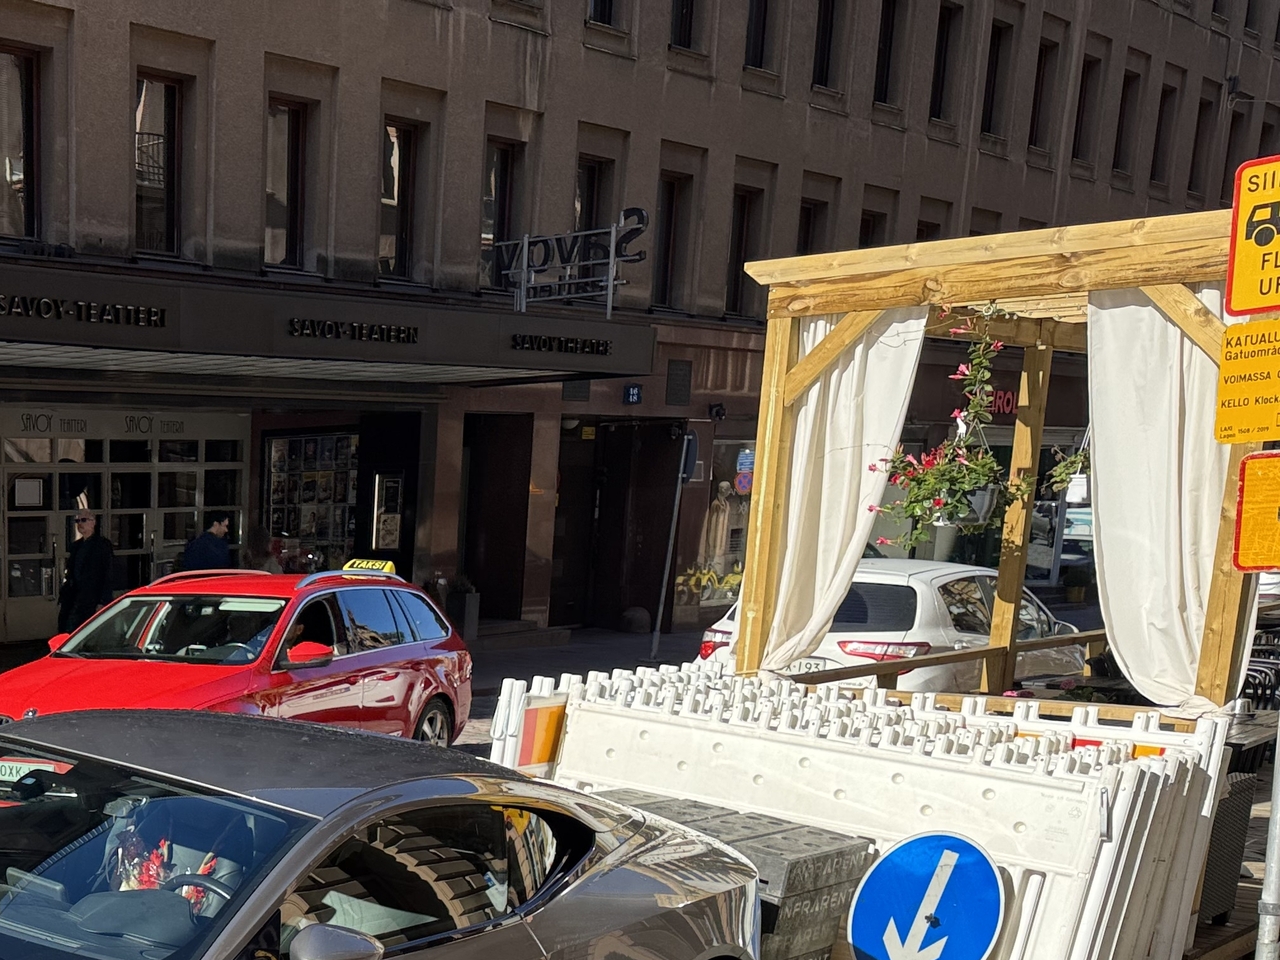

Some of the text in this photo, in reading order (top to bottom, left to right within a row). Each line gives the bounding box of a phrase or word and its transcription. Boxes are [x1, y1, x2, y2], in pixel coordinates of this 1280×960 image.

[1247, 171, 1280, 193] SII
[288, 318, 419, 344] SAVOY-TEATERN
[511, 333, 613, 356] SAVOY THEATRE
[1223, 371, 1271, 385] VOIMASSA
[1221, 395, 1280, 409] KELLO Klock
[21, 412, 54, 433] SAVOY
[124, 415, 155, 434] SAVOY
[352, 560, 386, 570] TAKSI
[779, 888, 855, 919] INFRARENT
